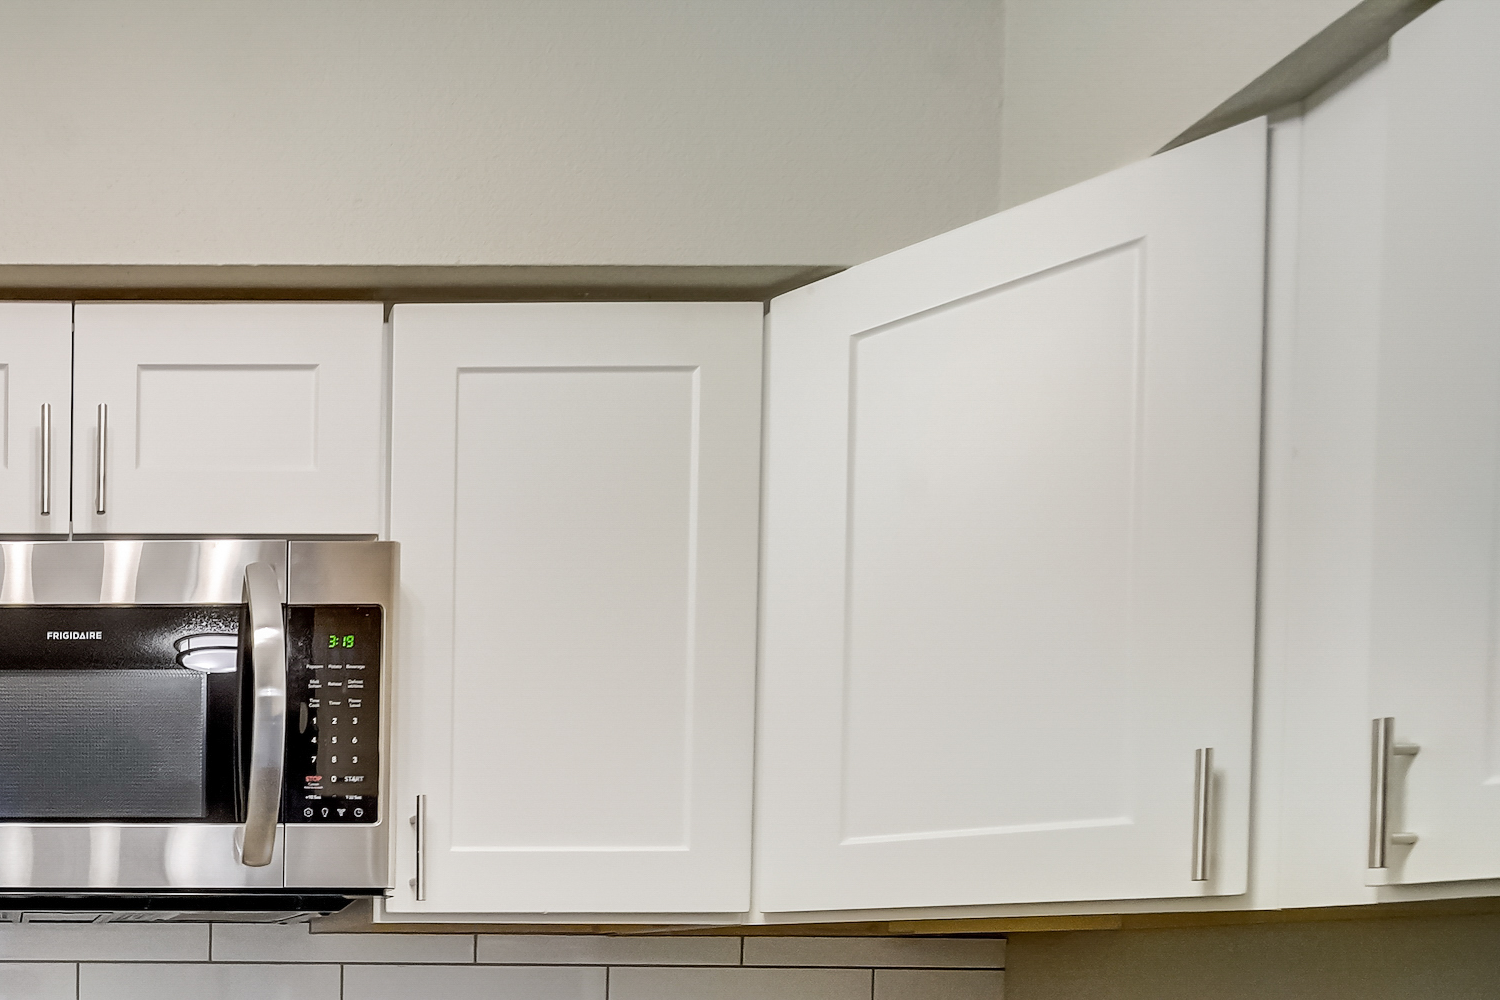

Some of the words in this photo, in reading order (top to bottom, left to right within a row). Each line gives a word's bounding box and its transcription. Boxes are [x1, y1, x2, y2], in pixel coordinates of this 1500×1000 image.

[46, 631, 103, 640] FRIGIDAIRE
[328, 634, 355, 648] 3:19
[312, 717, 317, 725] 1
[331, 717, 338, 725] 2
[352, 717, 358, 725] 3
[311, 736, 317, 744] 4
[331, 736, 338, 744] 5
[351, 736, 358, 744] 6
[311, 755, 317, 763] 7
[331, 755, 337, 763] 8
[330, 775, 337, 783] 0
